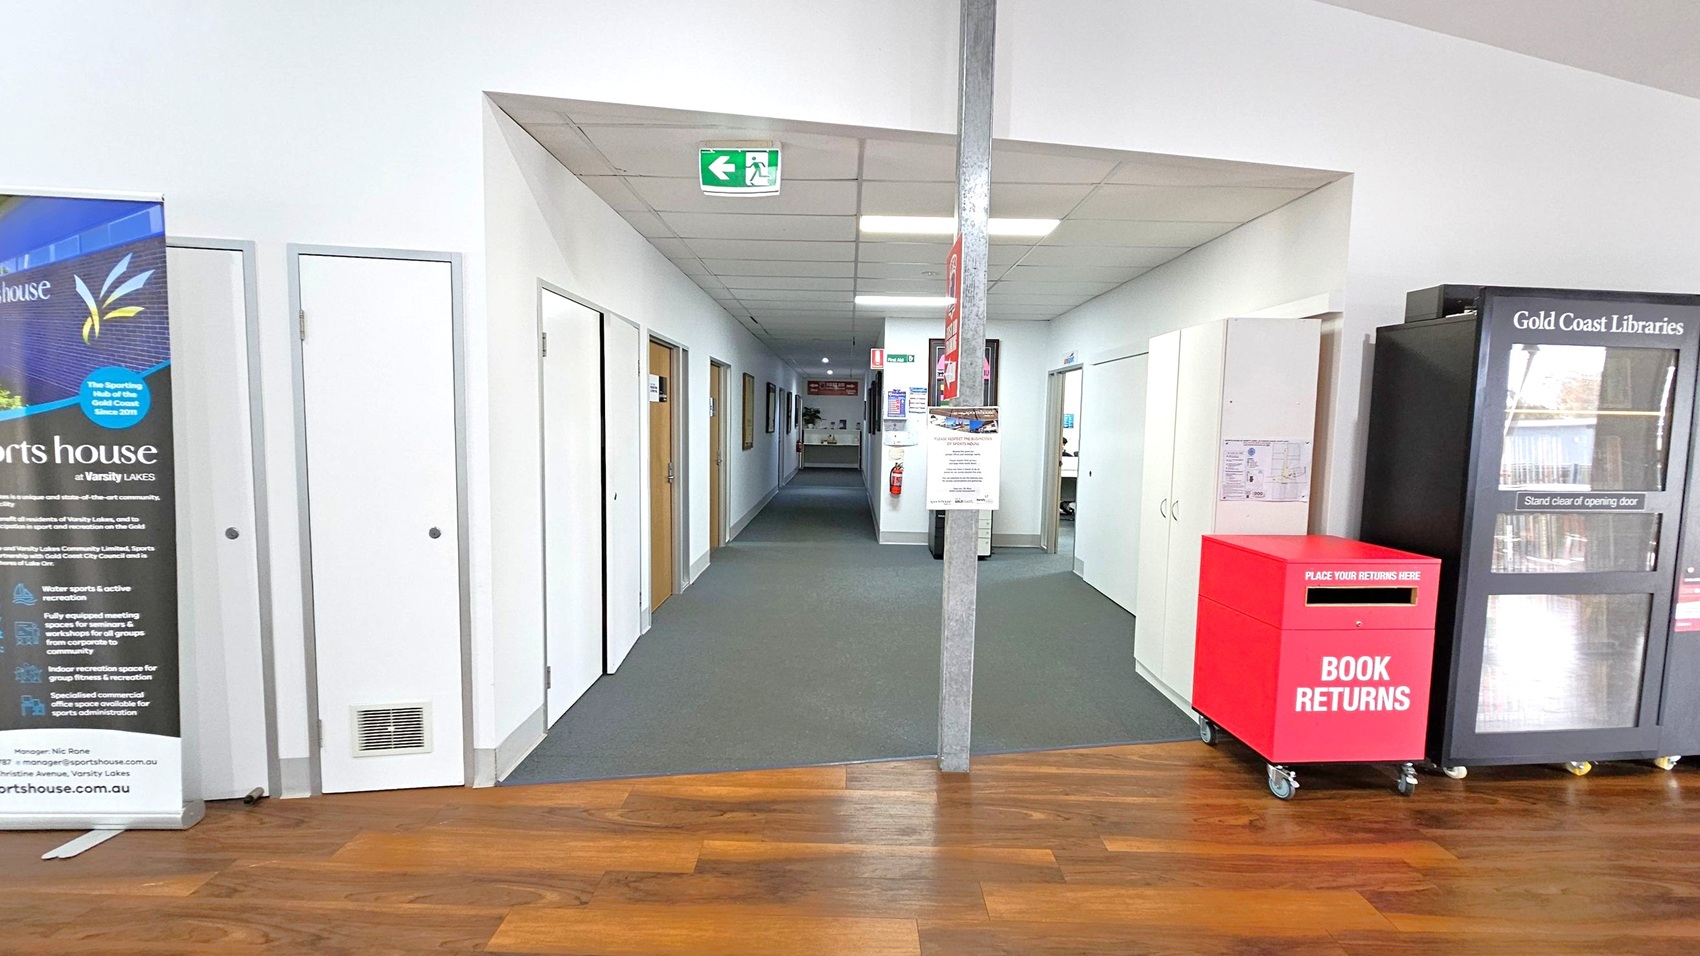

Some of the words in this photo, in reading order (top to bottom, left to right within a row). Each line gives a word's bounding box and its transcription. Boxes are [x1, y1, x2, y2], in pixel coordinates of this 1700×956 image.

[0, 280, 50, 302] house
[1513, 310, 1556, 330] Gold
[1559, 312, 1608, 332] Coast
[1610, 314, 1684, 335] Libraries
[104, 382, 143, 390] Sporting
[0, 440, 48, 464] rts
[54, 435, 158, 464] house
[84, 472, 122, 483] Varsity
[1524, 496, 1550, 506] Stand
[1552, 496, 1573, 506] clear
[1574, 496, 1584, 506] of
[1584, 496, 1617, 507] opening
[1619, 497, 1638, 506] door
[1305, 571, 1333, 581] PLACE
[1334, 571, 1357, 581] YOUR
[1359, 571, 1397, 581] RETURNS
[1399, 572, 1420, 580] HERE
[1320, 656, 1392, 682] BOOK
[1295, 686, 1410, 712] RETURNS
